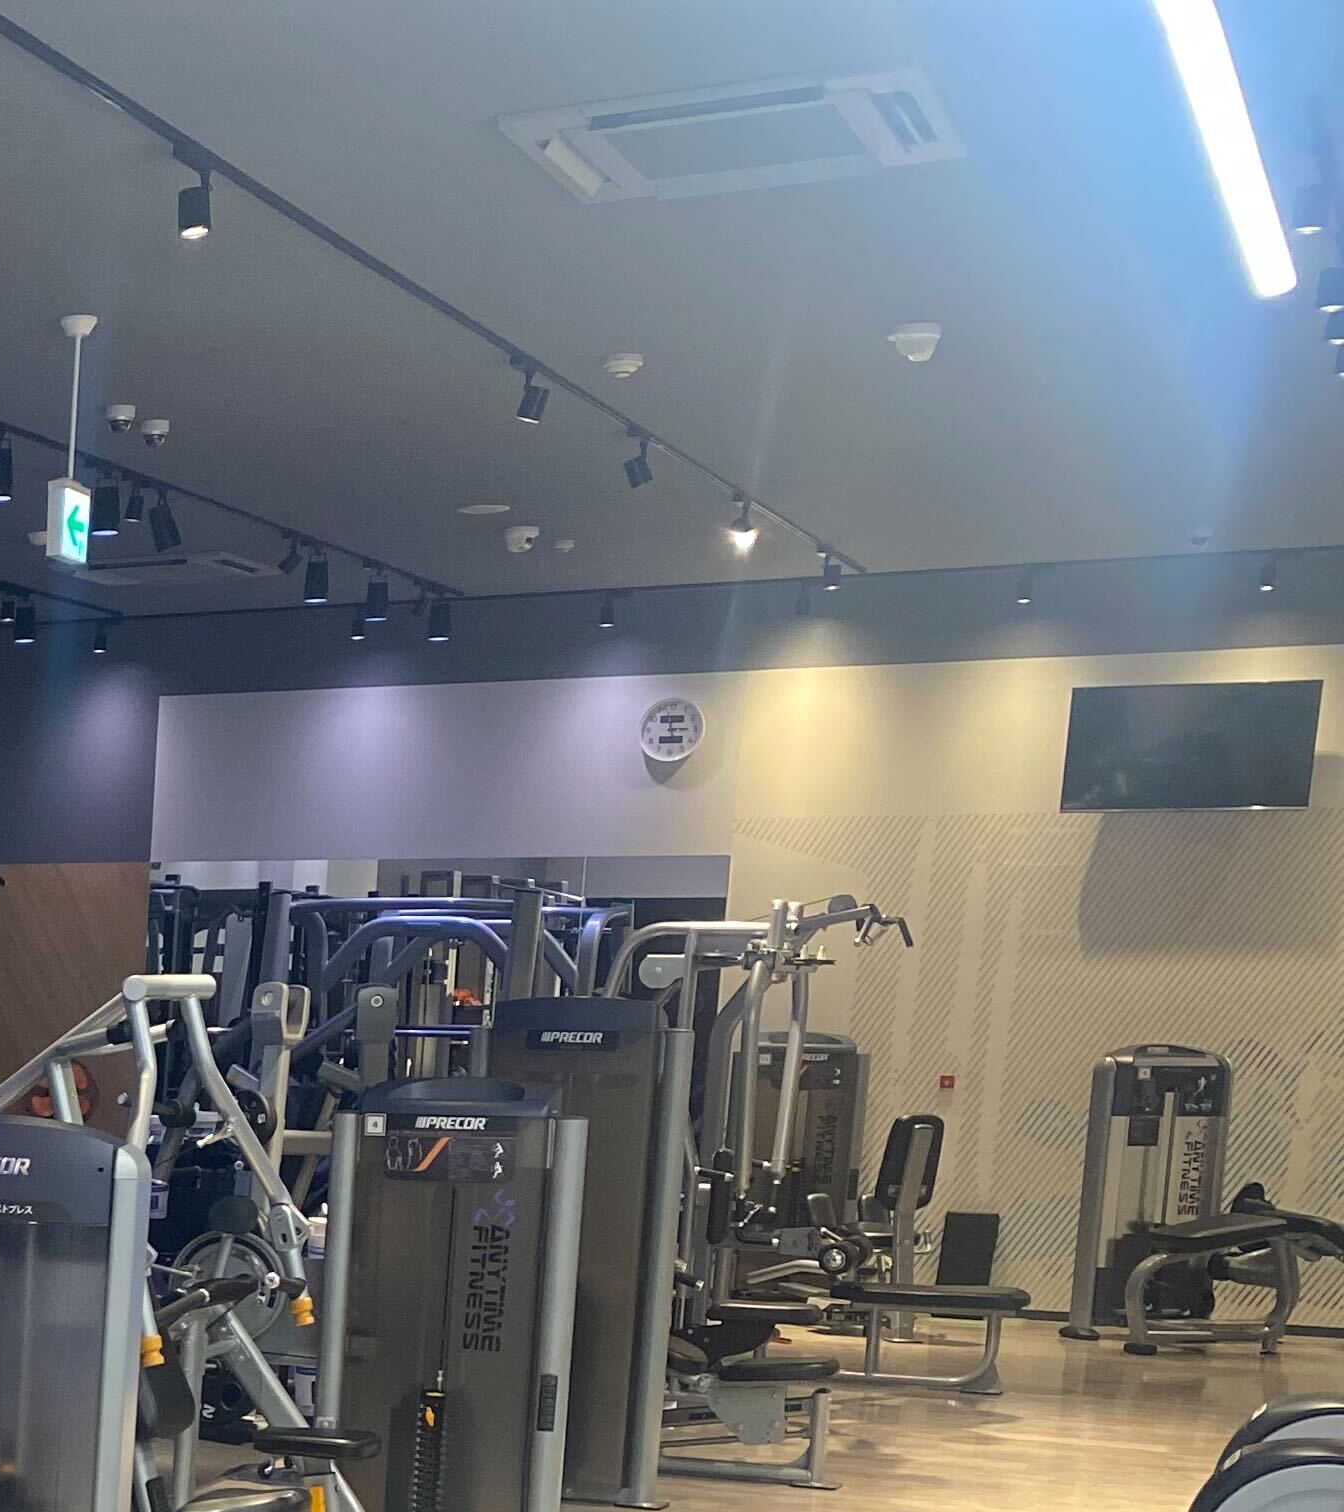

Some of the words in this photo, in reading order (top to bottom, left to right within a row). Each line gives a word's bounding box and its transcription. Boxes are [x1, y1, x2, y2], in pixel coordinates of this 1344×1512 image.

[550, 1031, 604, 1044] PRECOR
[425, 1116, 488, 1130] PRECOR
[1177, 1141, 1194, 1216] FITNESS
[1187, 1140, 1206, 1216] ANYTIME
[462, 1225, 490, 1350] FITNESS
[480, 1224, 511, 1353] ANYTIME
